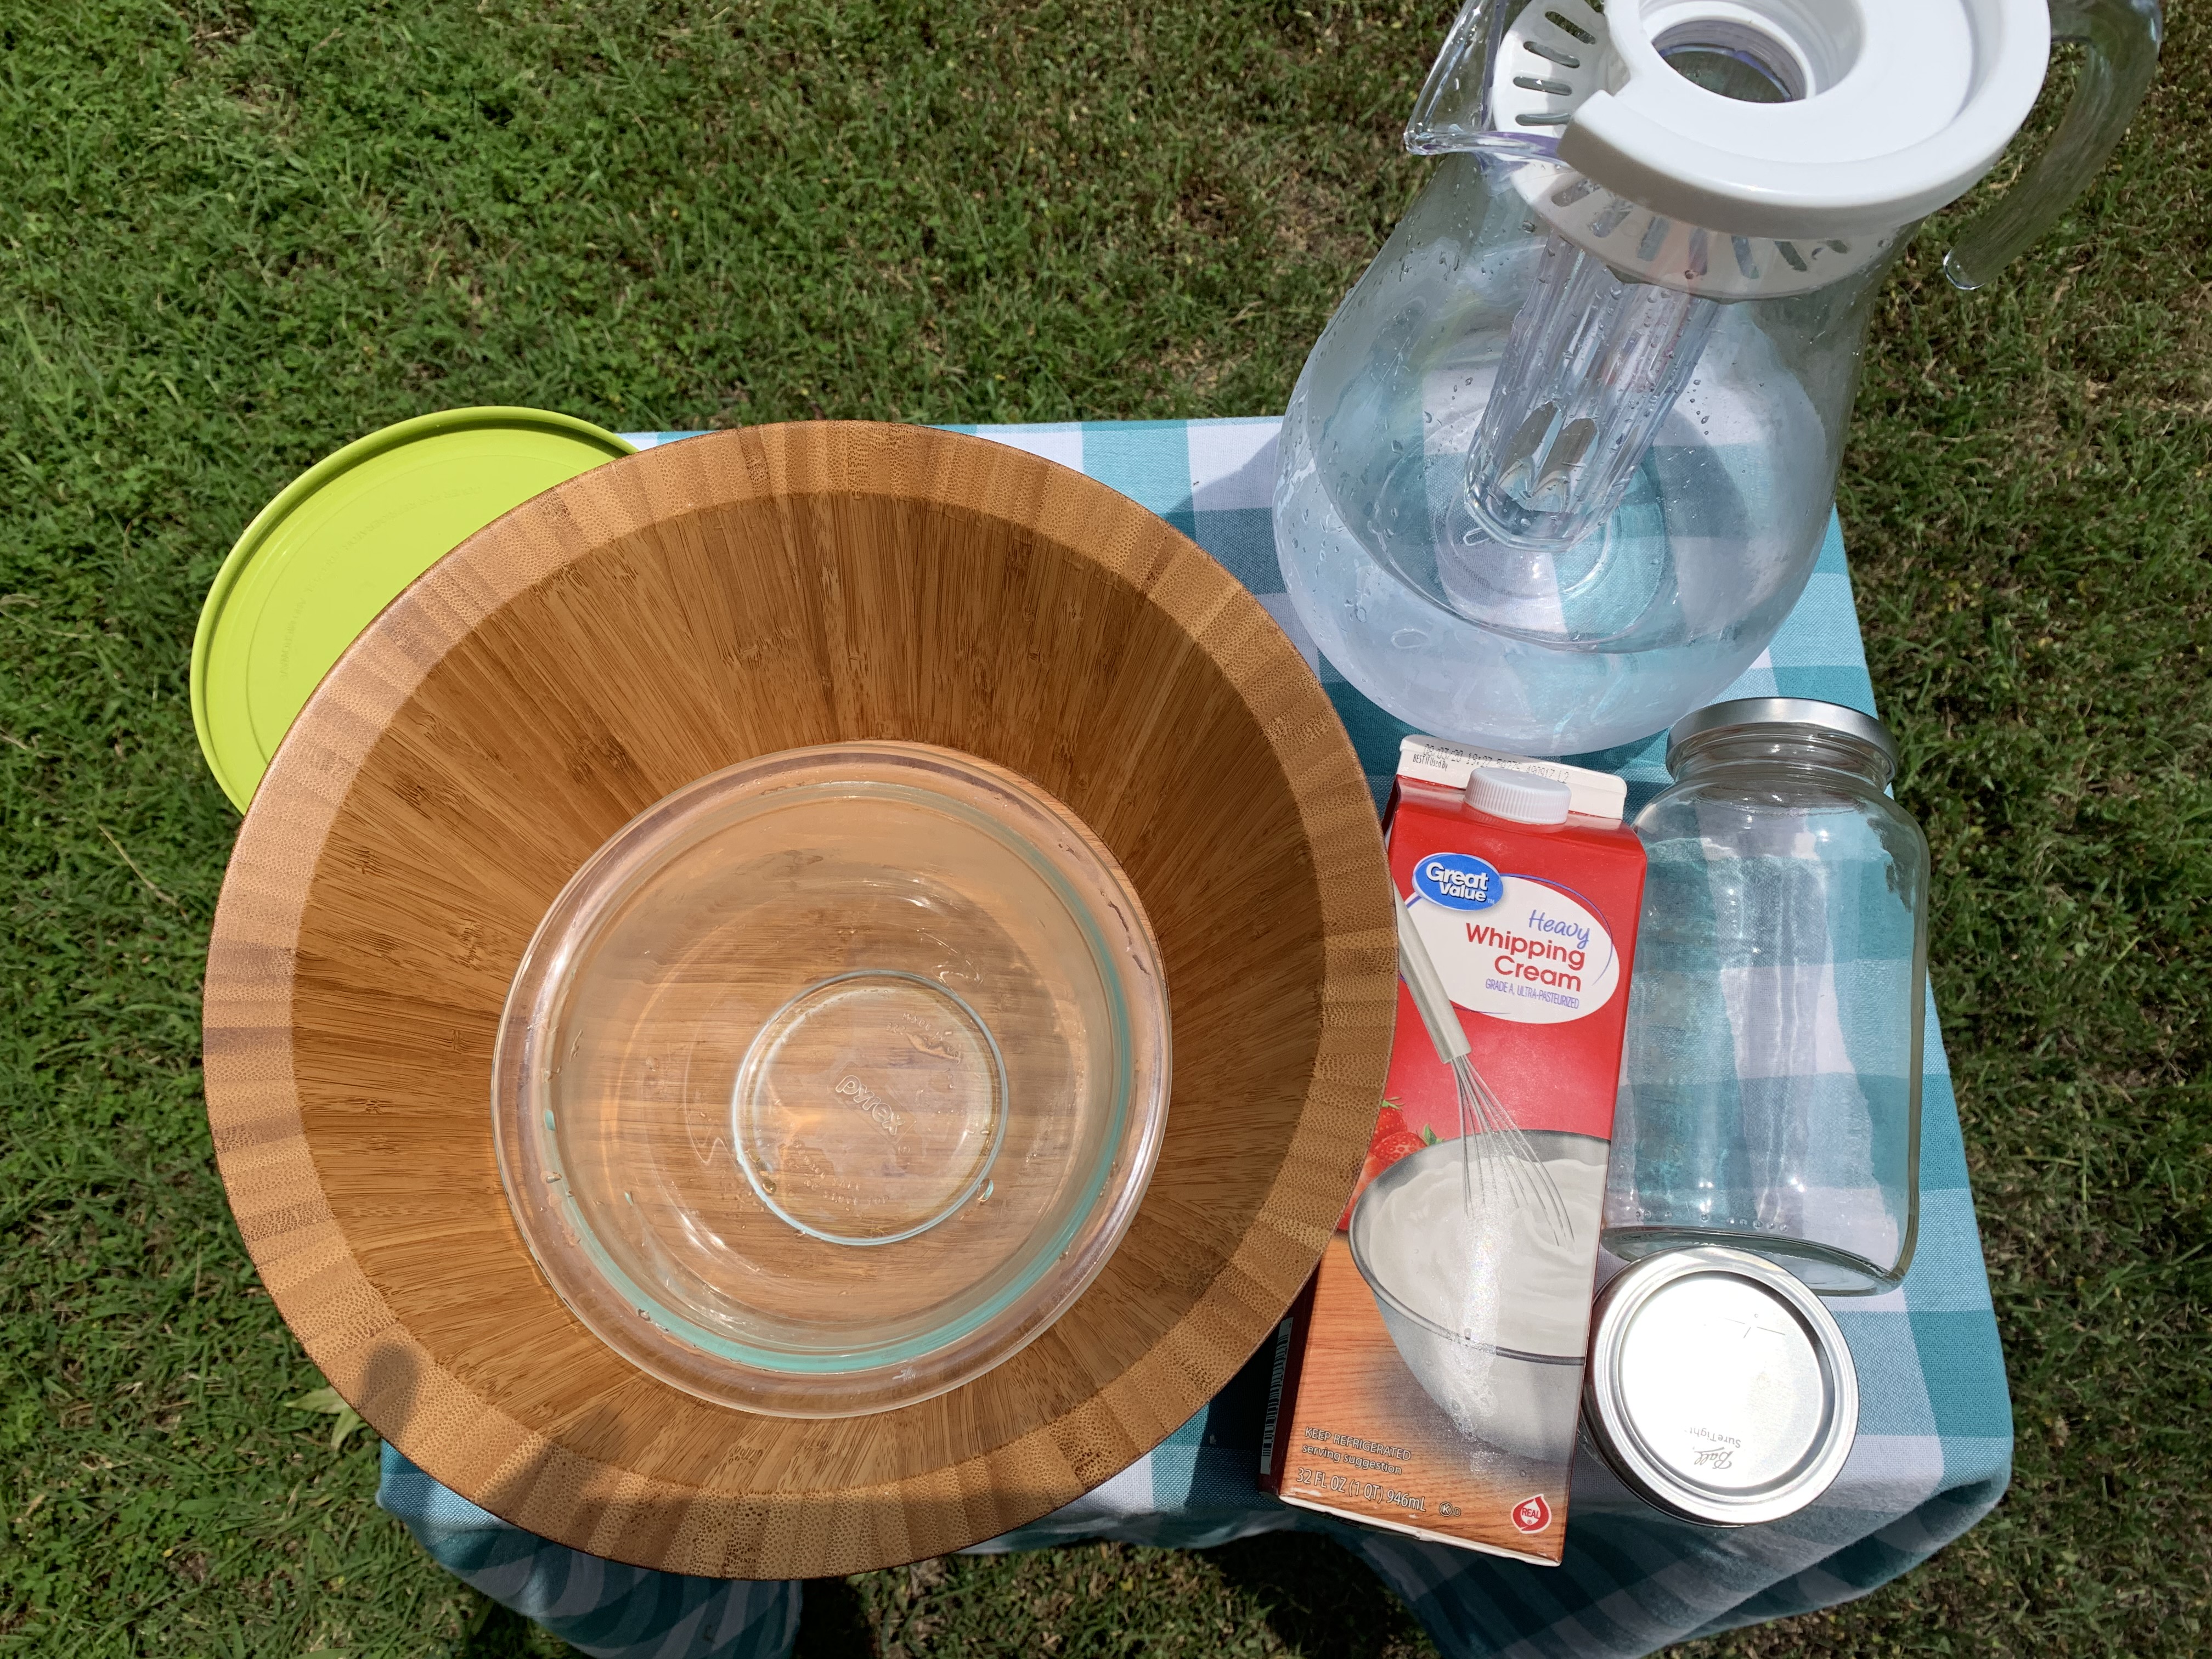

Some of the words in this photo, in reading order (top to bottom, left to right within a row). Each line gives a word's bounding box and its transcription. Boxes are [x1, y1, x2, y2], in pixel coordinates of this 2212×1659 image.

[1413, 754, 1424, 764] BEST
[1429, 755, 1442, 768] Used
[1441, 760, 1448, 771] By
[1426, 862, 1488, 891] Great
[1439, 882, 1486, 903] Value
[1528, 909, 1590, 950] Heavy
[1466, 923, 1585, 971] Whipping
[1494, 955, 1581, 992] Cream
[1485, 978, 1508, 993] GRADE
[1516, 985, 1580, 1010] ULTRA-PASTEURIZED
[834, 1074, 906, 1136] pyrex
[1301, 1444, 1341, 1462] serving
[1342, 1453, 1402, 1476] suggestion
[1305, 1426, 1331, 1442] KEEP
[1333, 1432, 1412, 1462] REFRIGERATED
[1694, 1447, 1734, 1470] Ball
[1295, 1467, 1312, 1485] 32
[1314, 1472, 1328, 1489] FL
[1330, 1476, 1346, 1493] OZ
[1348, 1480, 1361, 1498] (1
[1362, 1482, 1385, 1503] QT)
[1386, 1486, 1427, 1513] 946mL
[1521, 1506, 1541, 1520] REAL
